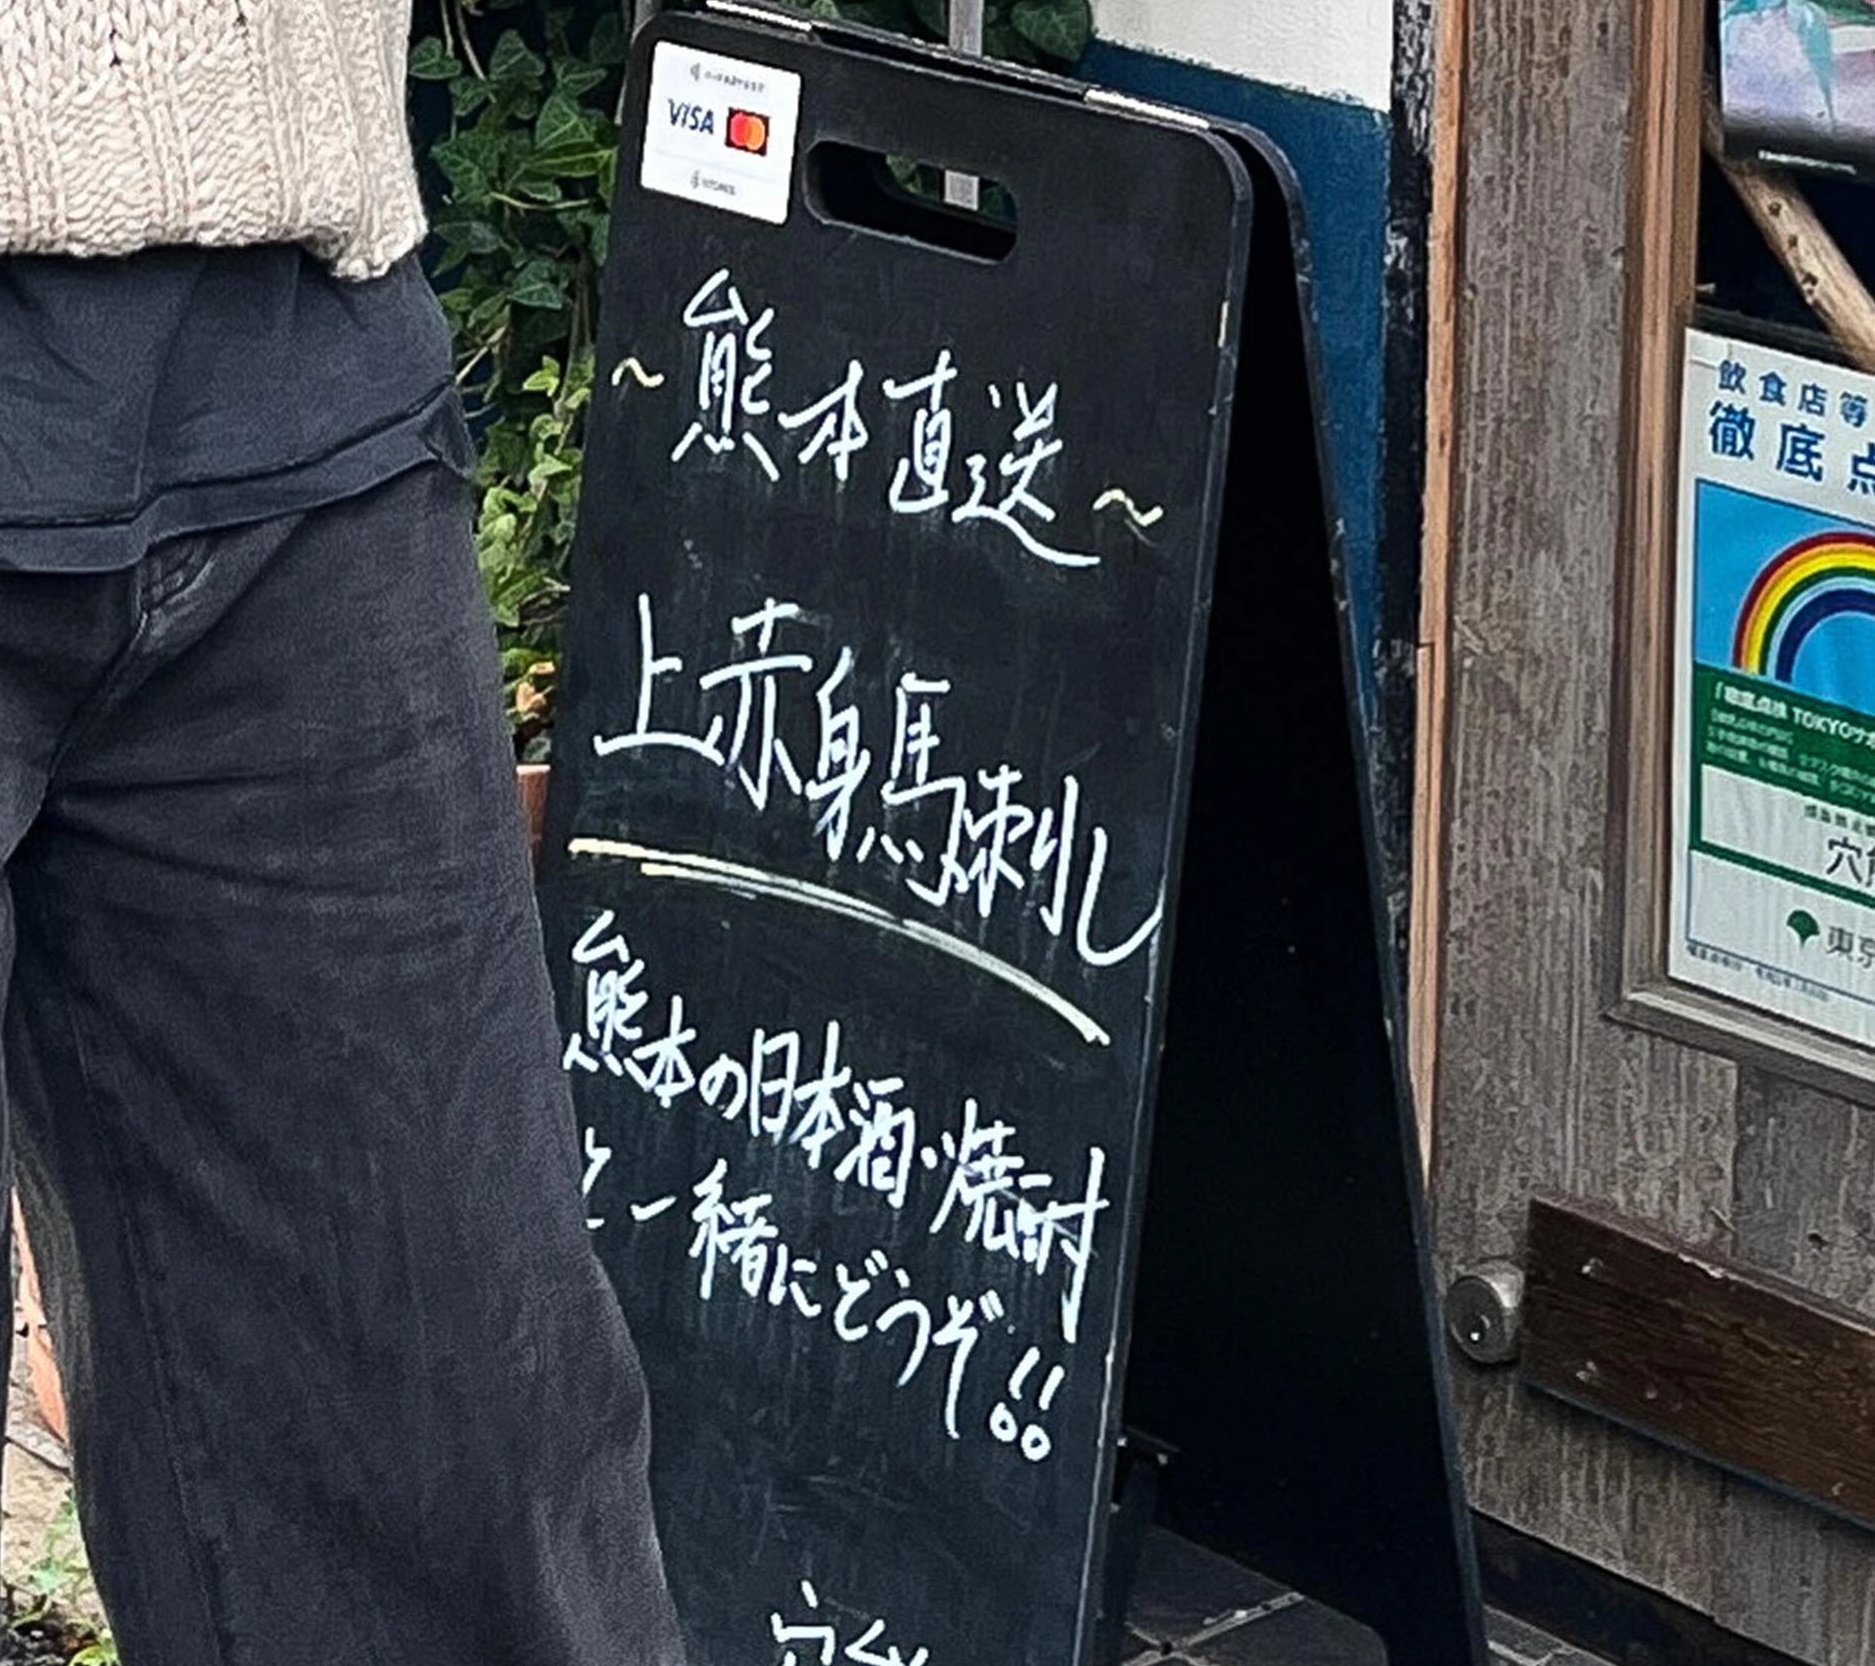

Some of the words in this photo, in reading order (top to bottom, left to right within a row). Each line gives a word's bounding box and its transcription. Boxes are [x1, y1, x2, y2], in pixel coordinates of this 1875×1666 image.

[667, 98, 715, 136] VISA
[1718, 359, 1869, 429] 飲食店等
[593, 593, 1166, 968] 上赤身馬刺し
